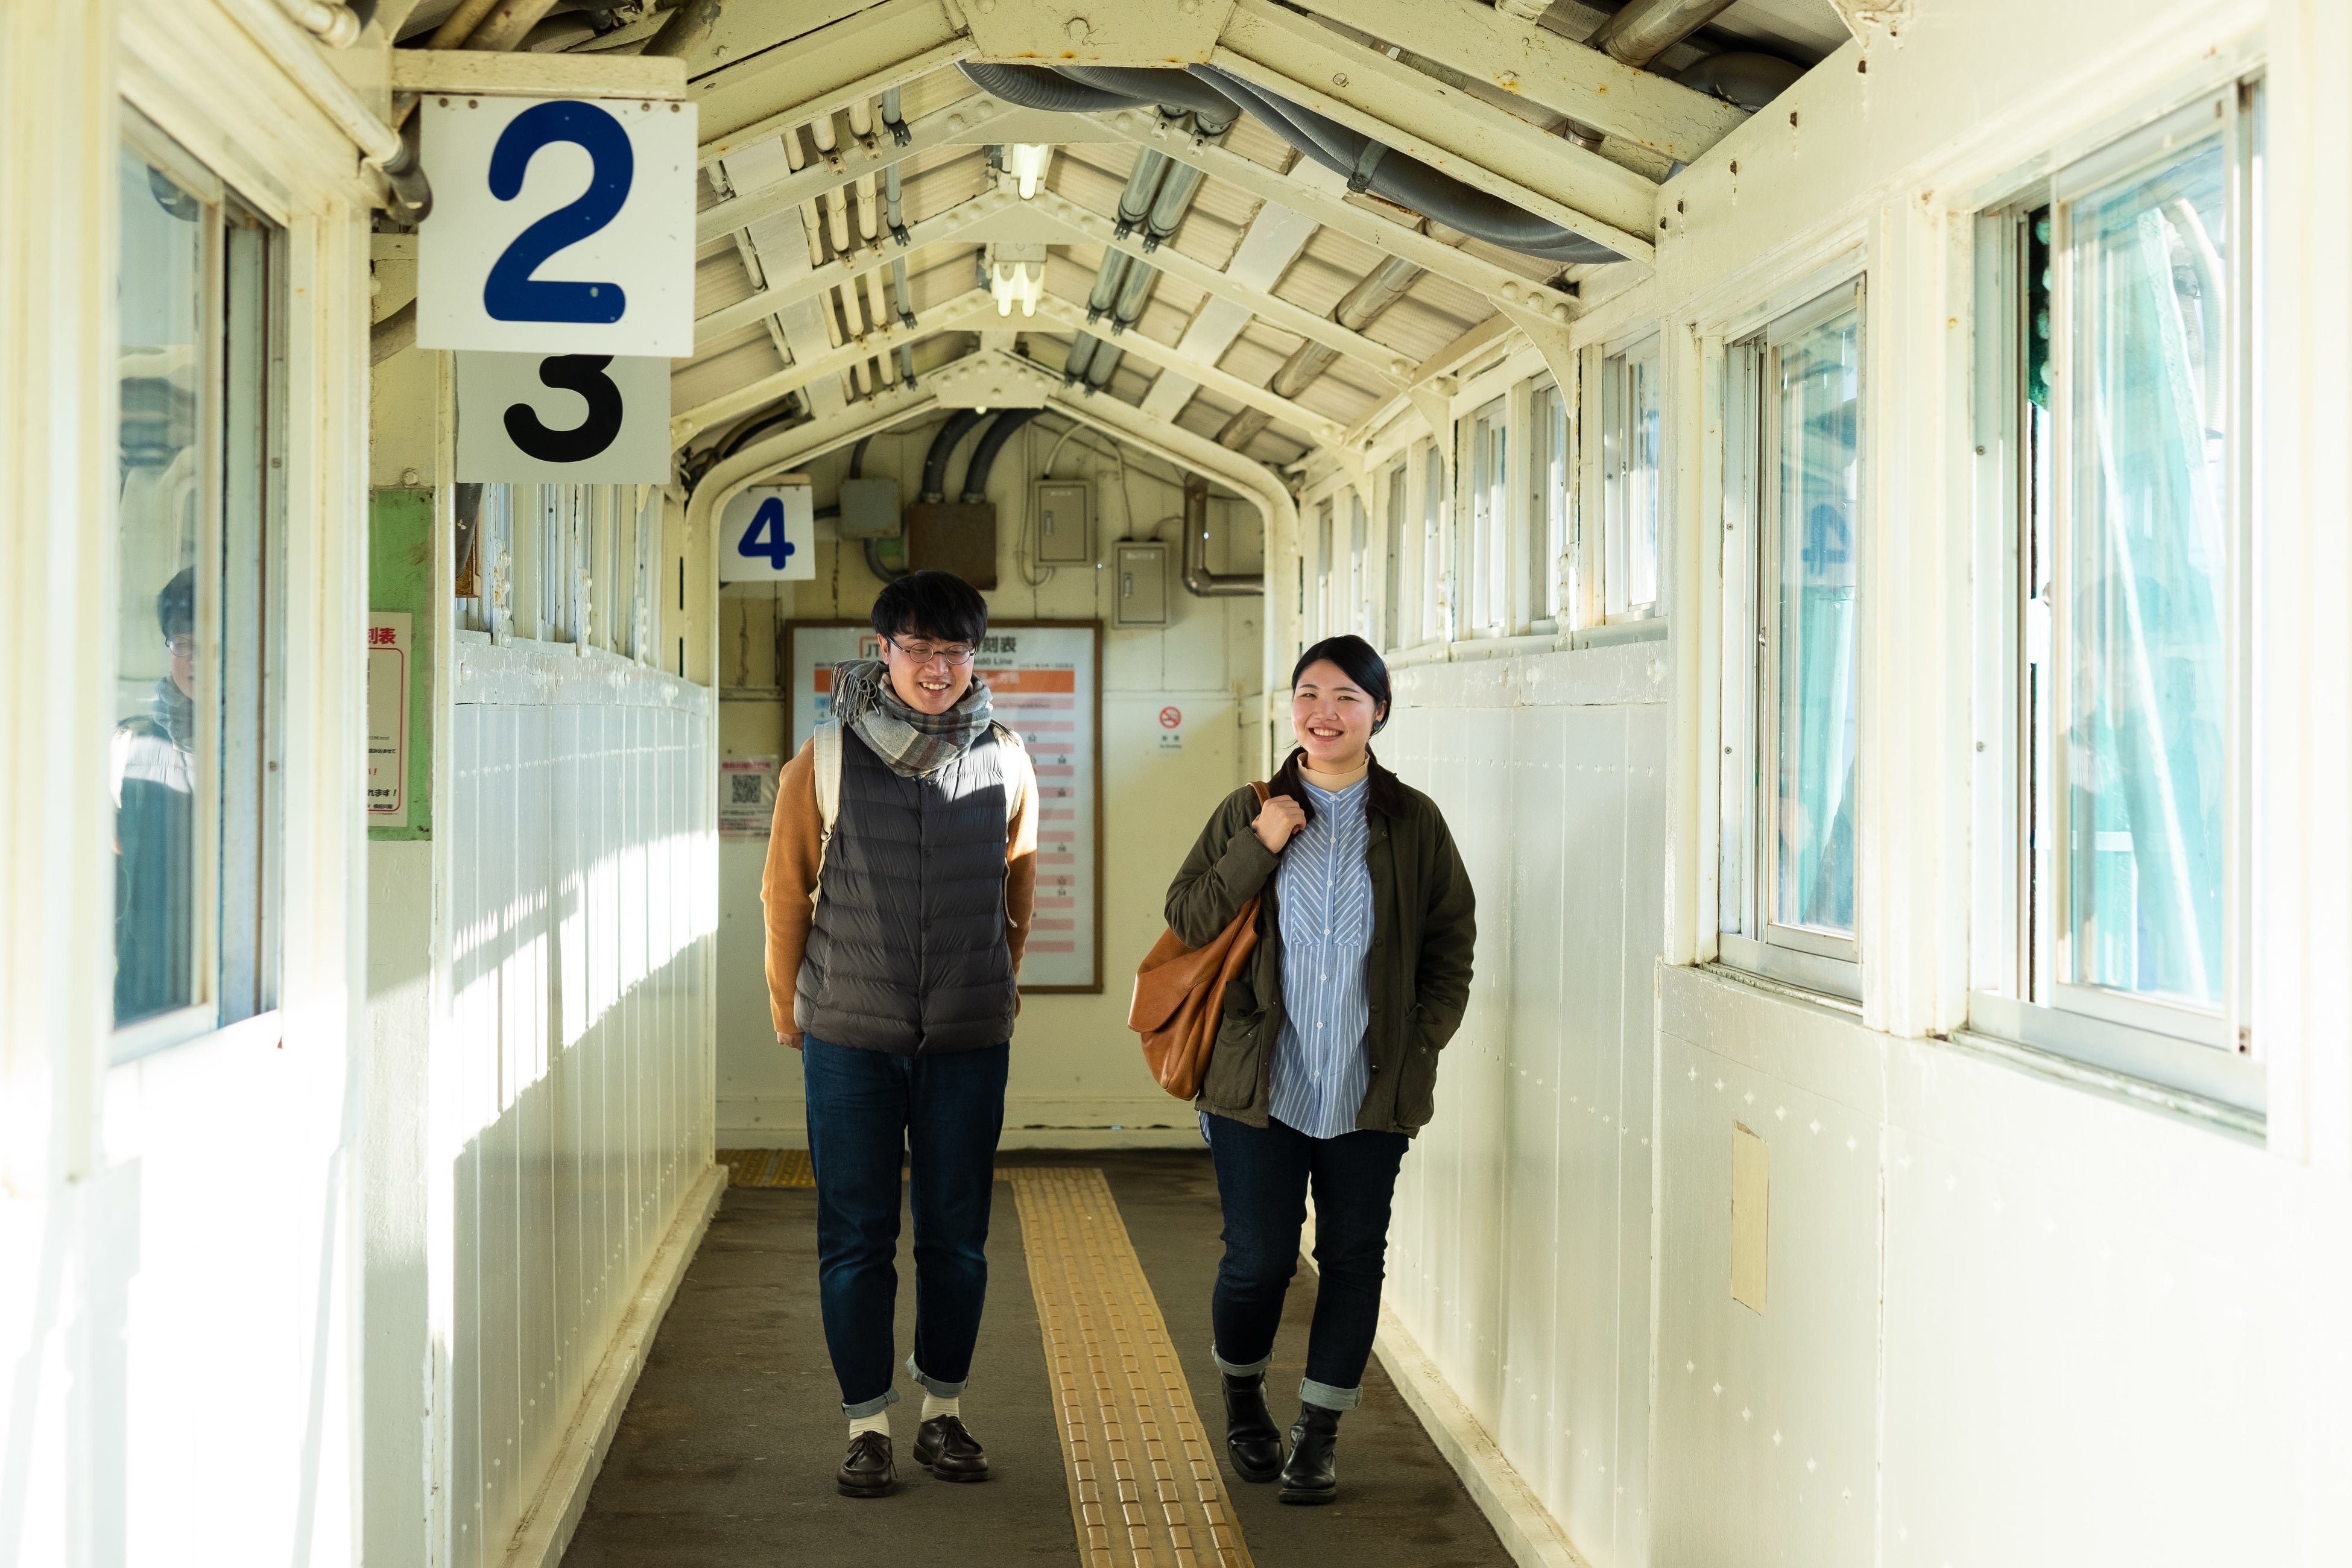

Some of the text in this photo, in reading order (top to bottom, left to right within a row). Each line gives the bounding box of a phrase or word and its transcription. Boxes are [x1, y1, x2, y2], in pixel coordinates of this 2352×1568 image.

[484, 100, 634, 323] 2
[503, 353, 623, 463] 3
[738, 496, 795, 570] 4
